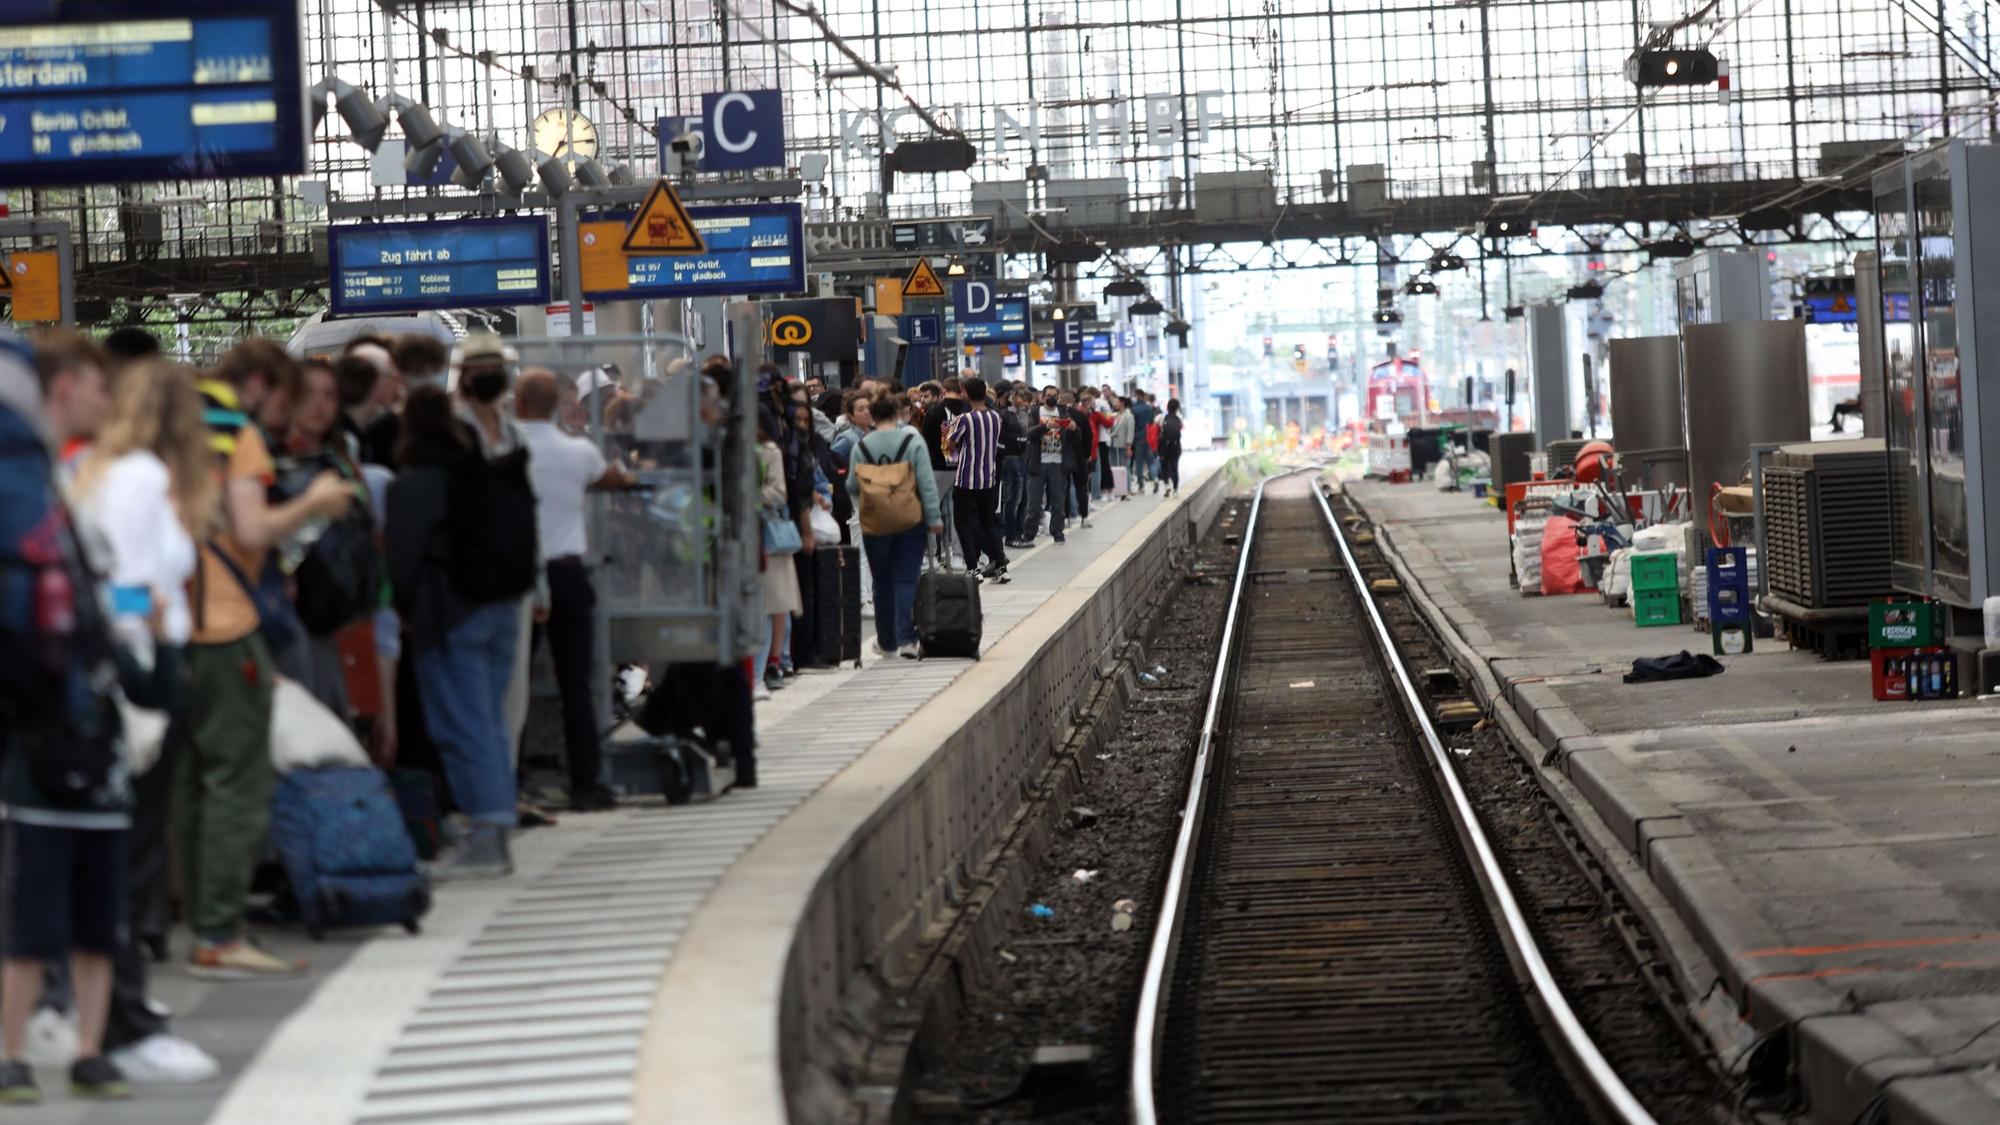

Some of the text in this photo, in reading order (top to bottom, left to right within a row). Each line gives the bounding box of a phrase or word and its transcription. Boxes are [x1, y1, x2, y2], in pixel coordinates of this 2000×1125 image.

[32, 111, 78, 133] Berlin
[713, 92, 758, 154] C
[1088, 90, 1224, 150] HBF
[33, 132, 142, 157] M gladbach
[381, 251, 401, 265] Zug
[437, 248, 450, 260] ab
[674, 262, 696, 271] Berlin
[393, 276, 403, 285] 27
[420, 274, 450, 284] Koblenz
[647, 275, 657, 283] 27
[674, 272, 683, 282] M
[692, 271, 726, 283] gladbach
[393, 287, 403, 296] 27
[421, 285, 451, 295] Koblenz
[967, 282, 990, 314] D
[1065, 321, 1080, 345] E
[1124, 330, 1135, 347] 5
[1881, 623, 1917, 638] ERDINGER
